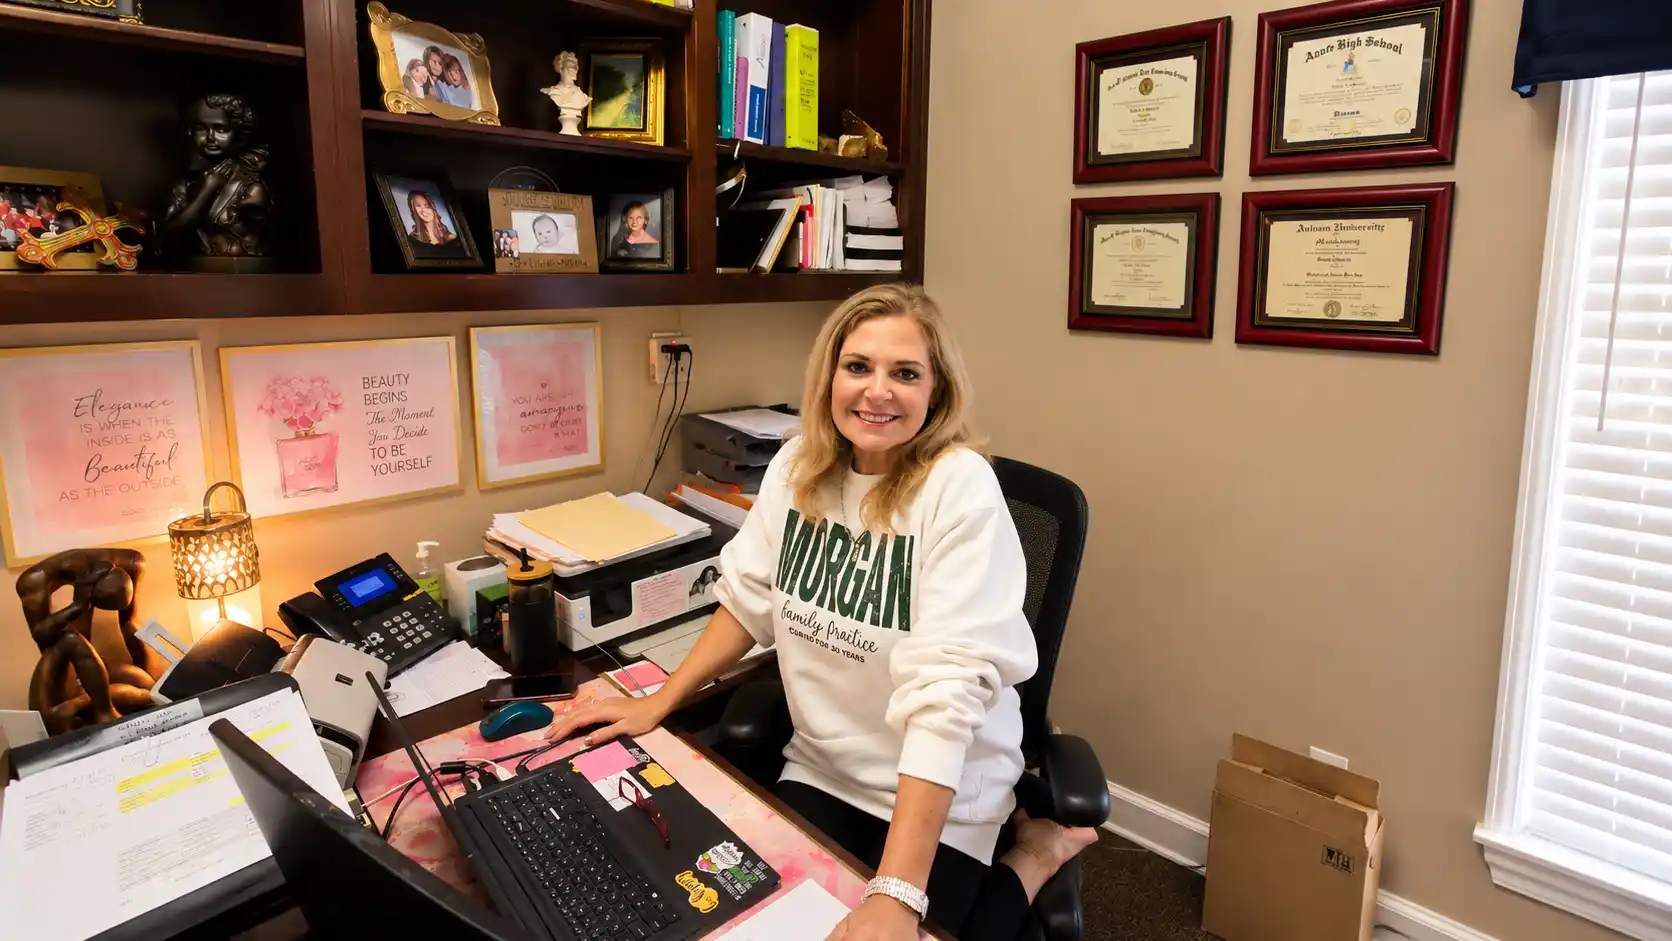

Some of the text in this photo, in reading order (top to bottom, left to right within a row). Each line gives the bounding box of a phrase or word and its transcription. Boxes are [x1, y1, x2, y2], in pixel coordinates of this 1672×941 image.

[1336, 37, 1362, 50] High
[1365, 36, 1403, 55] School
[1333, 222, 1386, 233] University
[362, 373, 410, 389] BEAUTY
[73, 387, 175, 424] Elegance
[363, 390, 408, 406] BEGINS
[80, 415, 174, 434] IS WHEN THE
[365, 407, 435, 425] The Moment
[86, 429, 177, 448] INSIDE IS AS
[392, 425, 429, 441] Decide
[369, 444, 406, 460] TO BE
[84, 442, 179, 483] Beautiful
[371, 455, 433, 477] YOURSELF
[59, 477, 182, 502] AS THE OUTSIDE
[775, 508, 915, 632] MORGAN
[841, 650, 865, 663] YEARS
